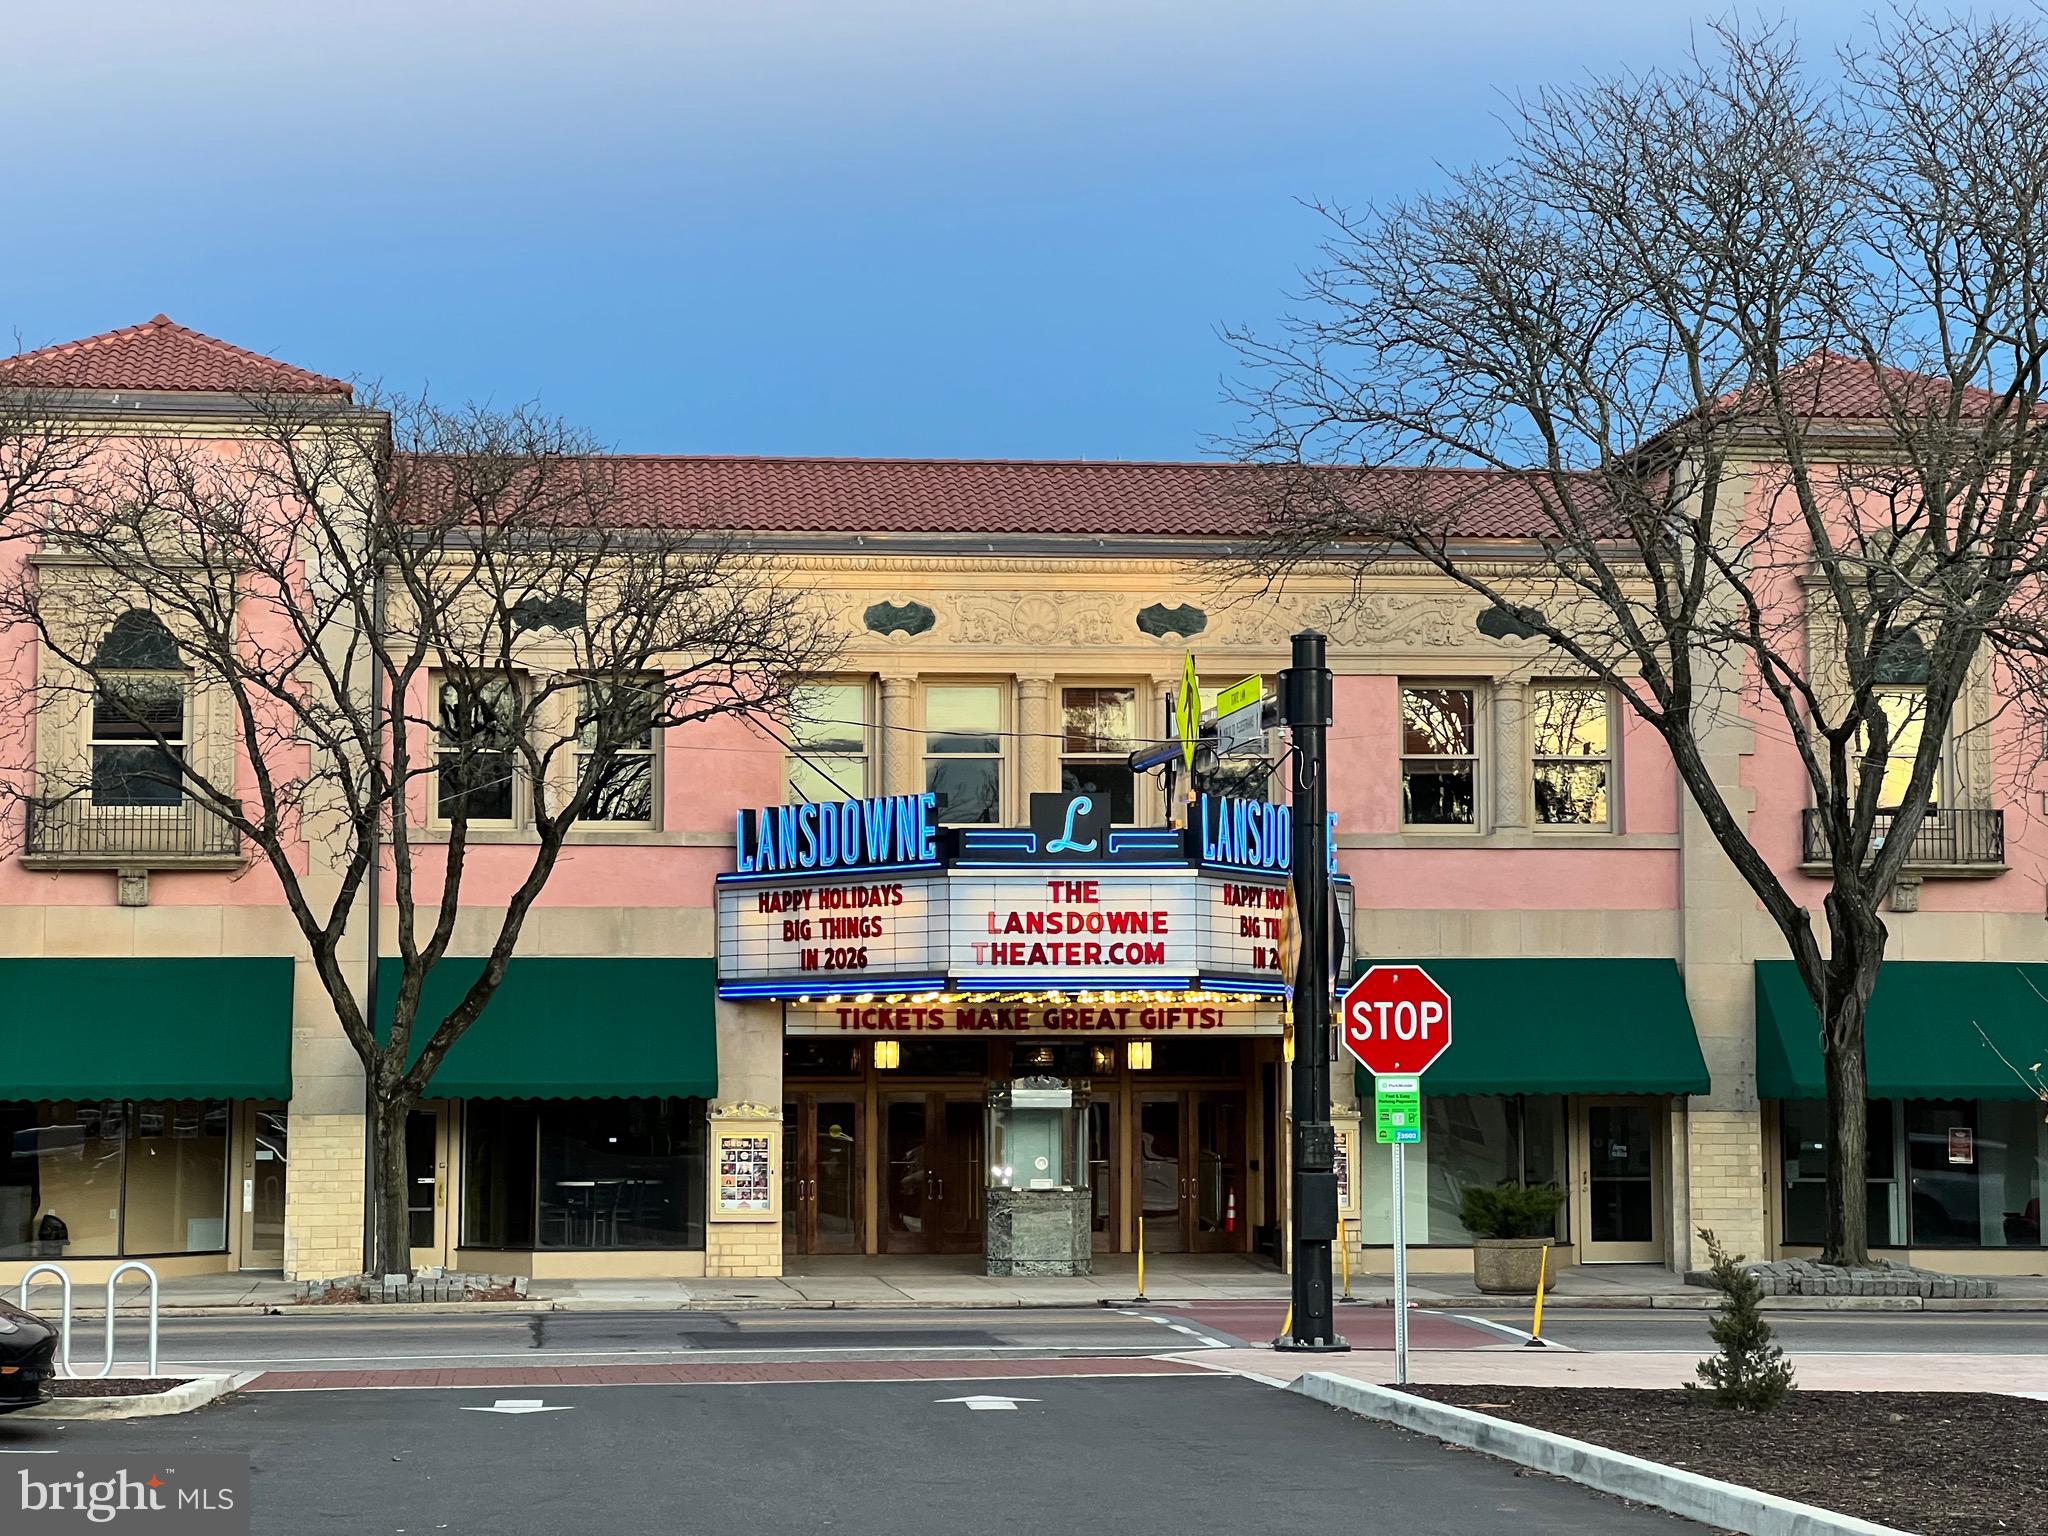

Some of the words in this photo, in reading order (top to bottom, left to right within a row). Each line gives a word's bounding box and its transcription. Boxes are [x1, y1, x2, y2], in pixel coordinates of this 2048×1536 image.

[737, 792, 936, 872] LANSDOWNE
[1046, 796, 1098, 853] L
[1201, 792, 1338, 874] LANSDOE
[758, 888, 813, 913] HAPPY
[818, 884, 903, 910] HOLIDAYS
[1047, 881, 1100, 904] THE
[1223, 883, 1263, 908] HAPPY
[783, 919, 812, 942] BIG
[819, 916, 883, 940] THINGS
[987, 911, 1169, 935] LANSDOWNE
[1240, 915, 1260, 938] BIG
[800, 948, 819, 970] IN
[824, 946, 868, 970] 2026
[971, 942, 1165, 965] THEATER.COM
[1253, 946, 1266, 969] IN
[836, 1007, 944, 1030] TICKETS
[956, 1007, 1030, 1030] MAKE
[1043, 1007, 1126, 1030] GREAT
[1139, 1007, 1224, 1029] GIFTS!
[1350, 1001, 1443, 1041] STOP
